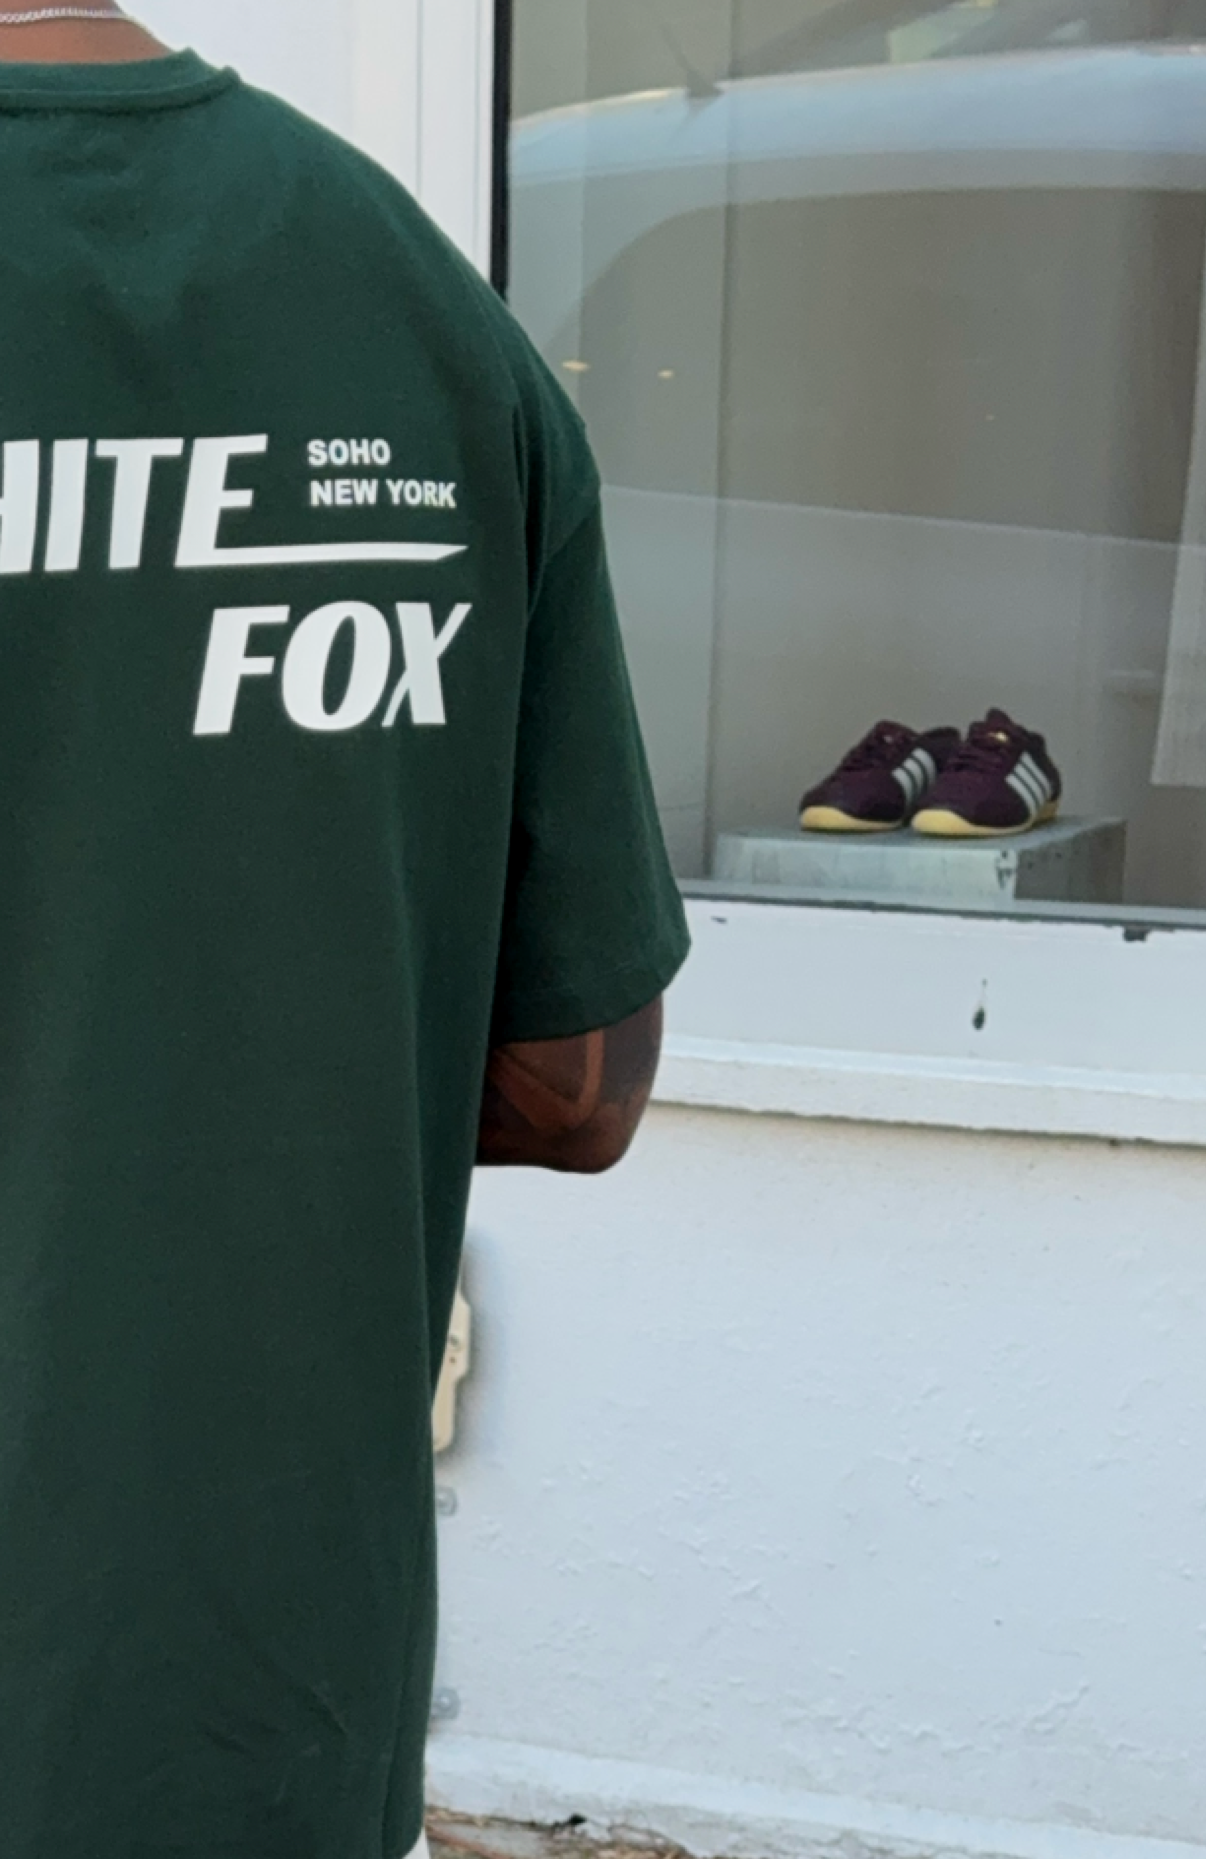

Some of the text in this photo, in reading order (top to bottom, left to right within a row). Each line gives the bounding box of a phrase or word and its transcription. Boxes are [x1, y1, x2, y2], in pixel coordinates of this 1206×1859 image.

[306, 437, 392, 468] SOHO
[309, 478, 457, 509] NEW YORK
[192, 600, 473, 736] FOX
